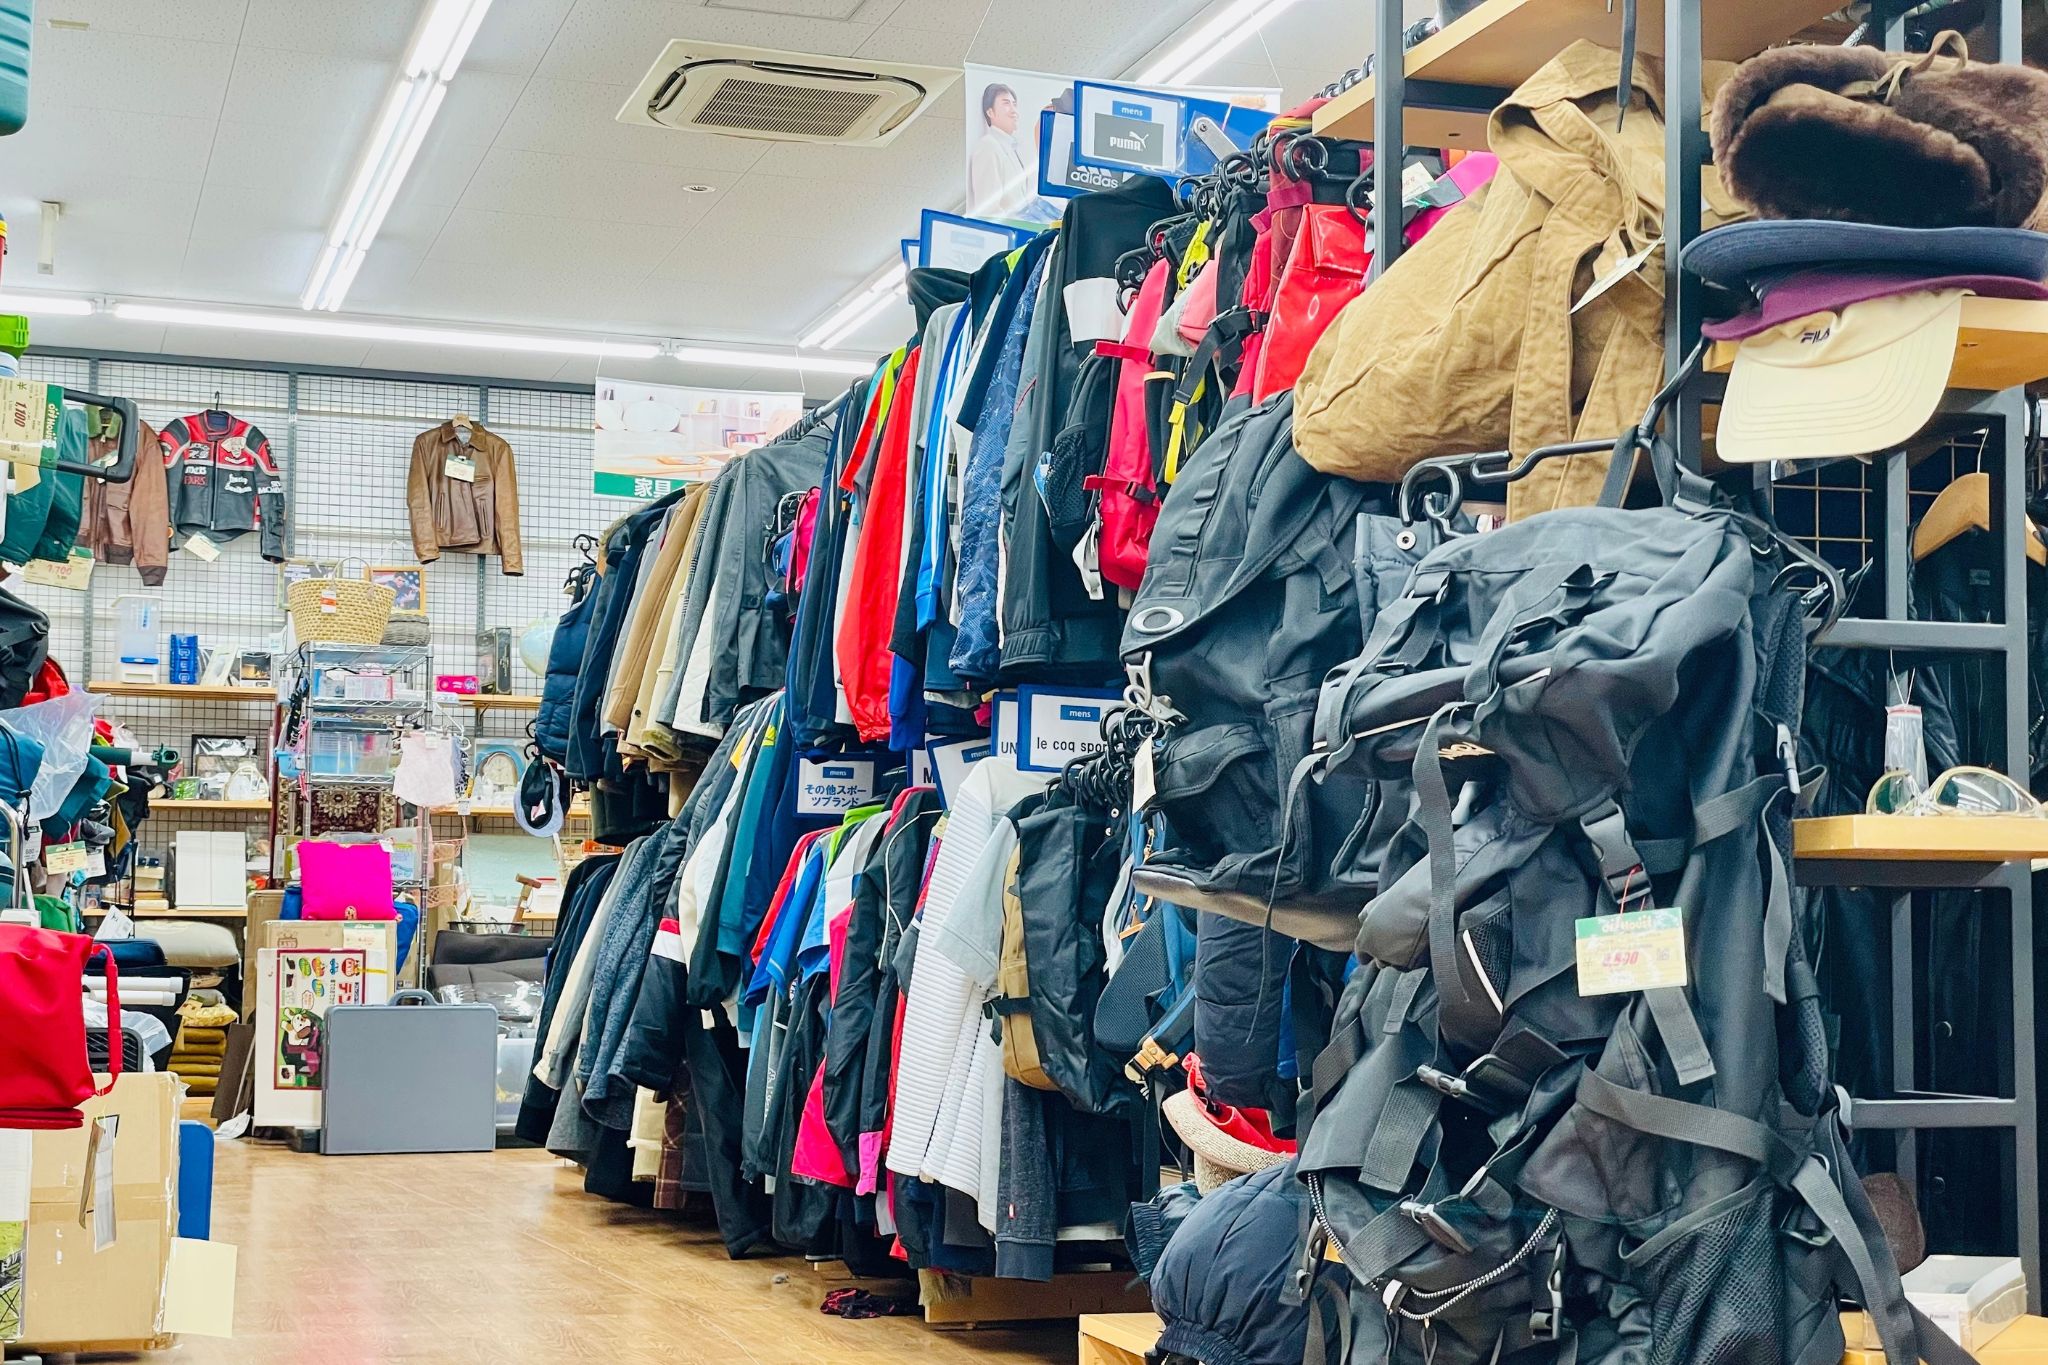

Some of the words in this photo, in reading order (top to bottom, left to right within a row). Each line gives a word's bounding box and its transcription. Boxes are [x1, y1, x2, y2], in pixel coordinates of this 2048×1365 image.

[1121, 107, 1143, 117] mens
[1109, 136, 1142, 151] PUMA
[1070, 171, 1118, 189] adidas
[1801, 328, 1830, 344] FILA
[634, 478, 671, 497] 家具
[1069, 709, 1091, 718] mens
[1037, 737, 1047, 750] le
[1053, 739, 1075, 752] coq
[1080, 742, 1108, 754] spor
[805, 784, 866, 796] その他スポー
[811, 796, 859, 808] ツブランド
